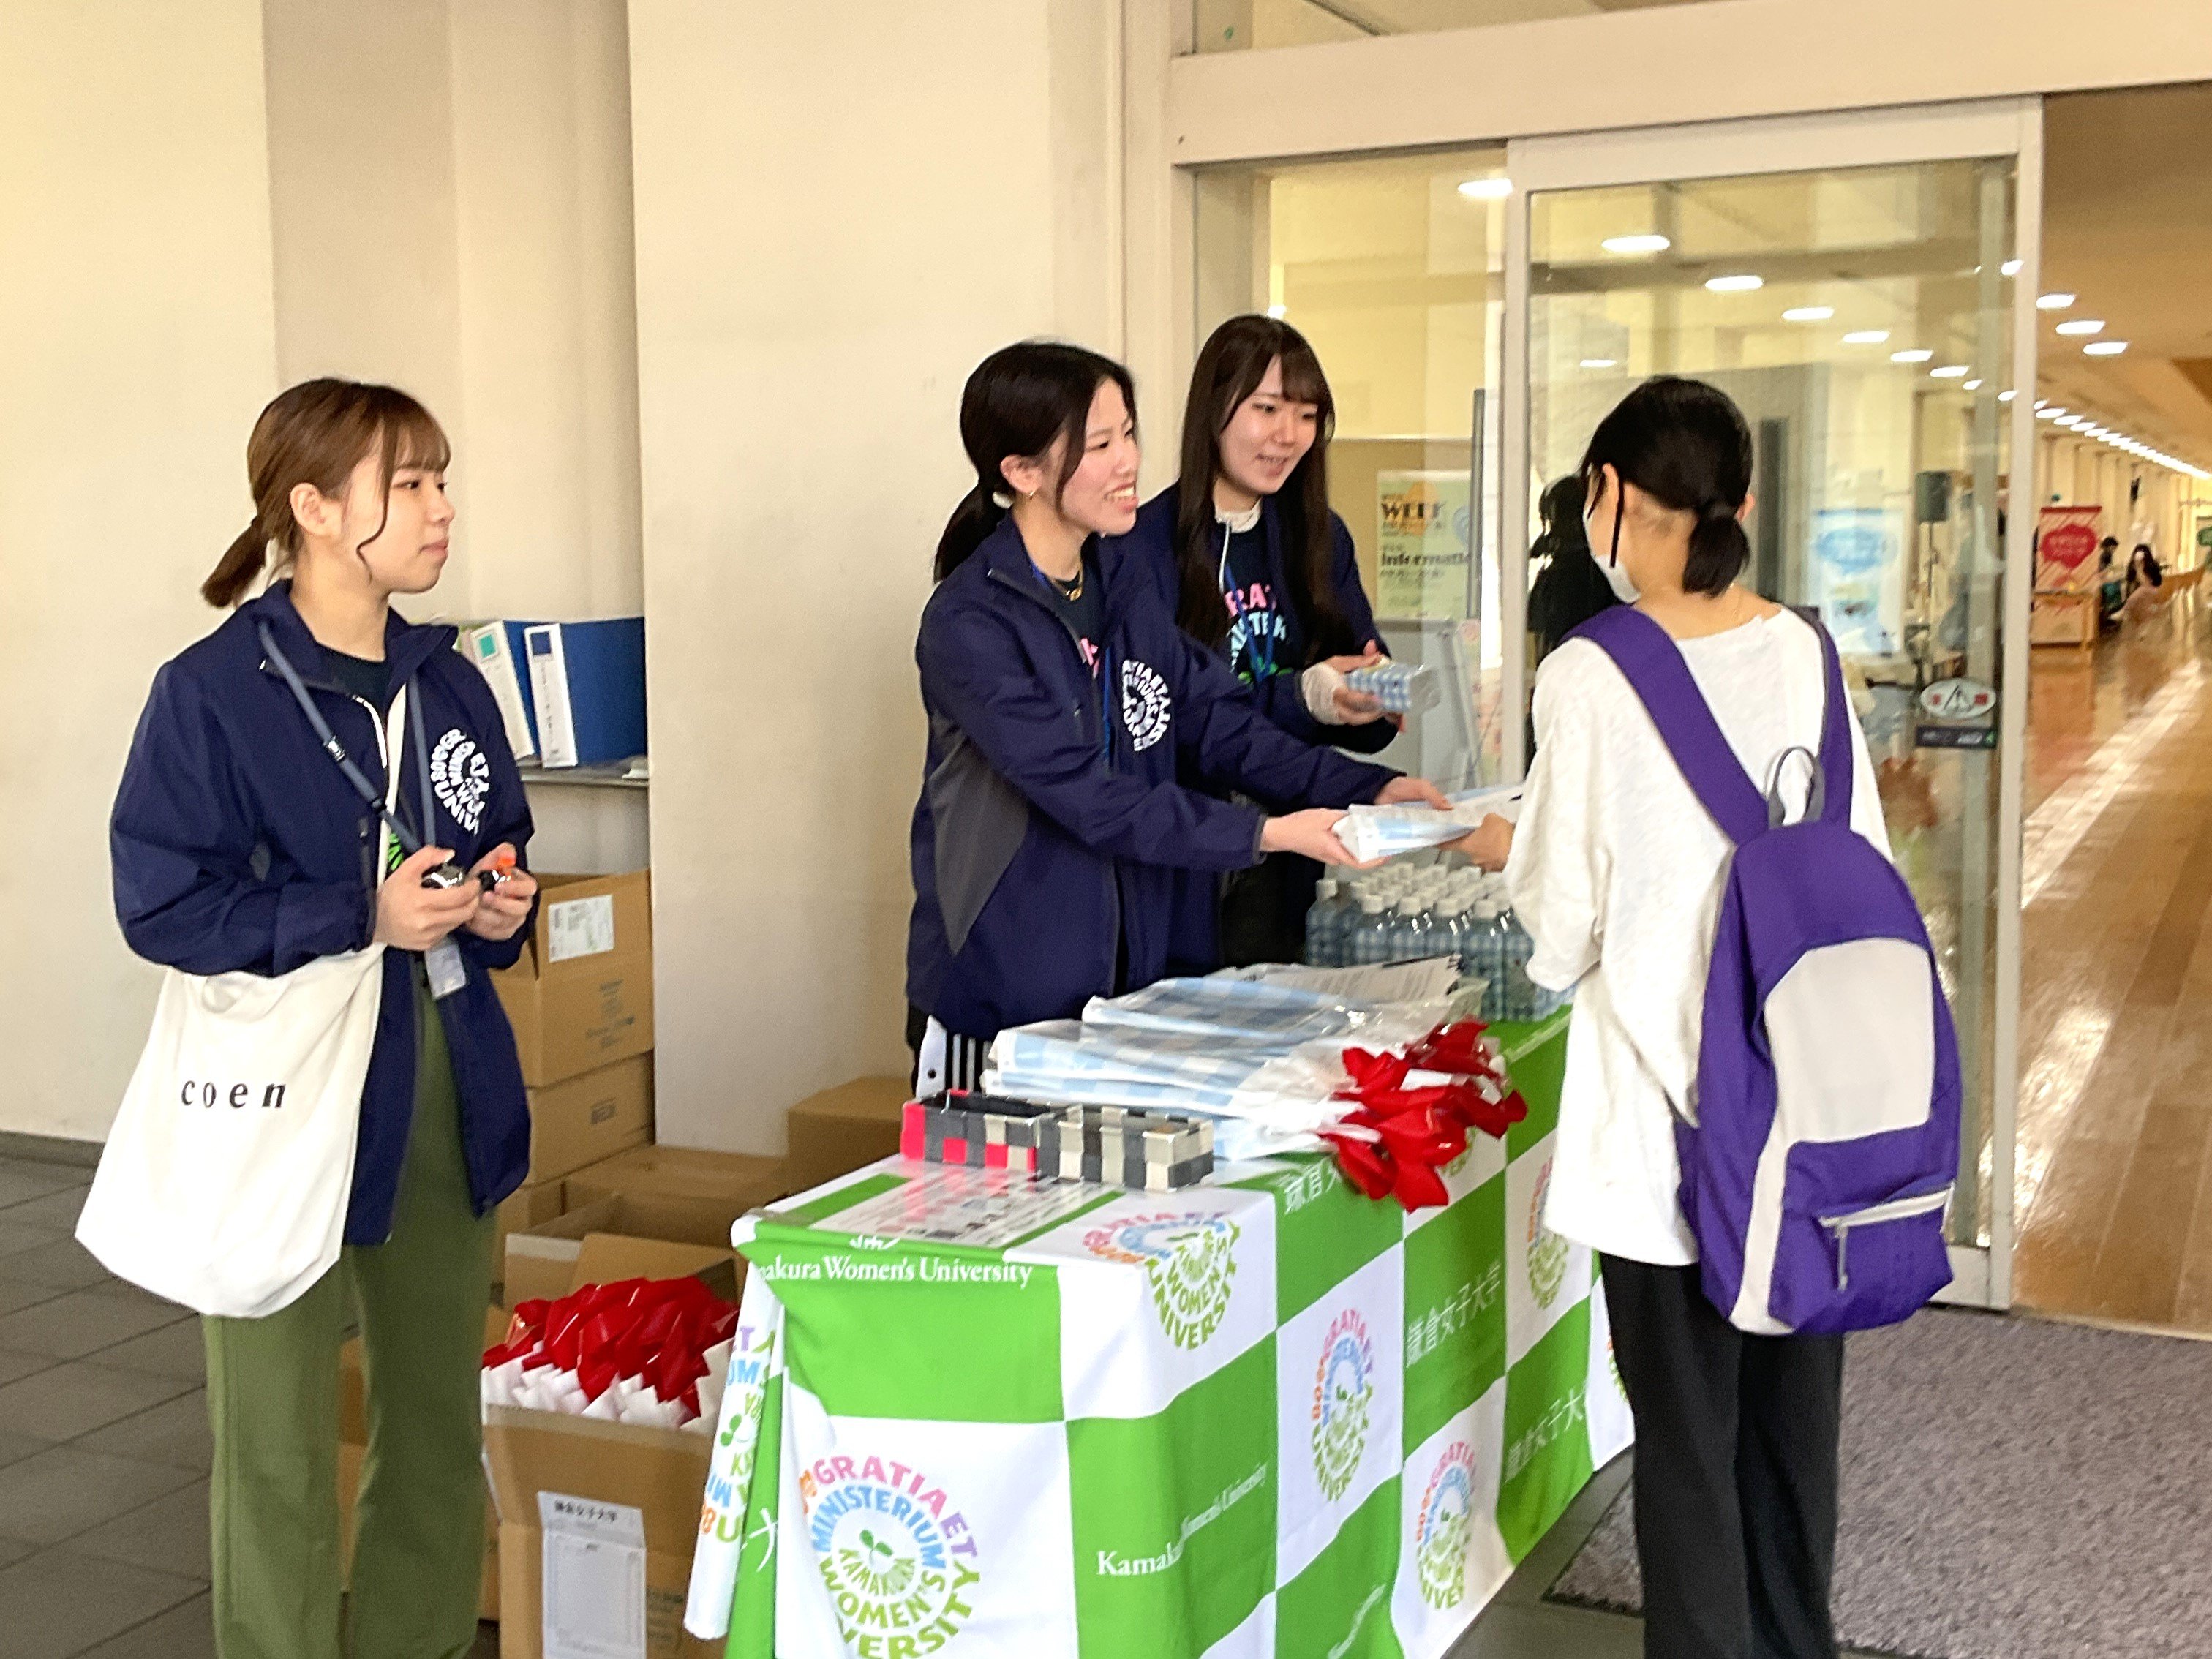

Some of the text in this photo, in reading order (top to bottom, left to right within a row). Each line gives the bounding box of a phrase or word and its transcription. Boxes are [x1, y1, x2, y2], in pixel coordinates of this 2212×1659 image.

[181, 1079, 286, 1109] coen
[759, 1255, 1033, 1290] akura Women's University
[811, 1484, 947, 1569] MINISTERIUM
[813, 1455, 947, 1519] GRATIA
[940, 1511, 978, 1557] ET
